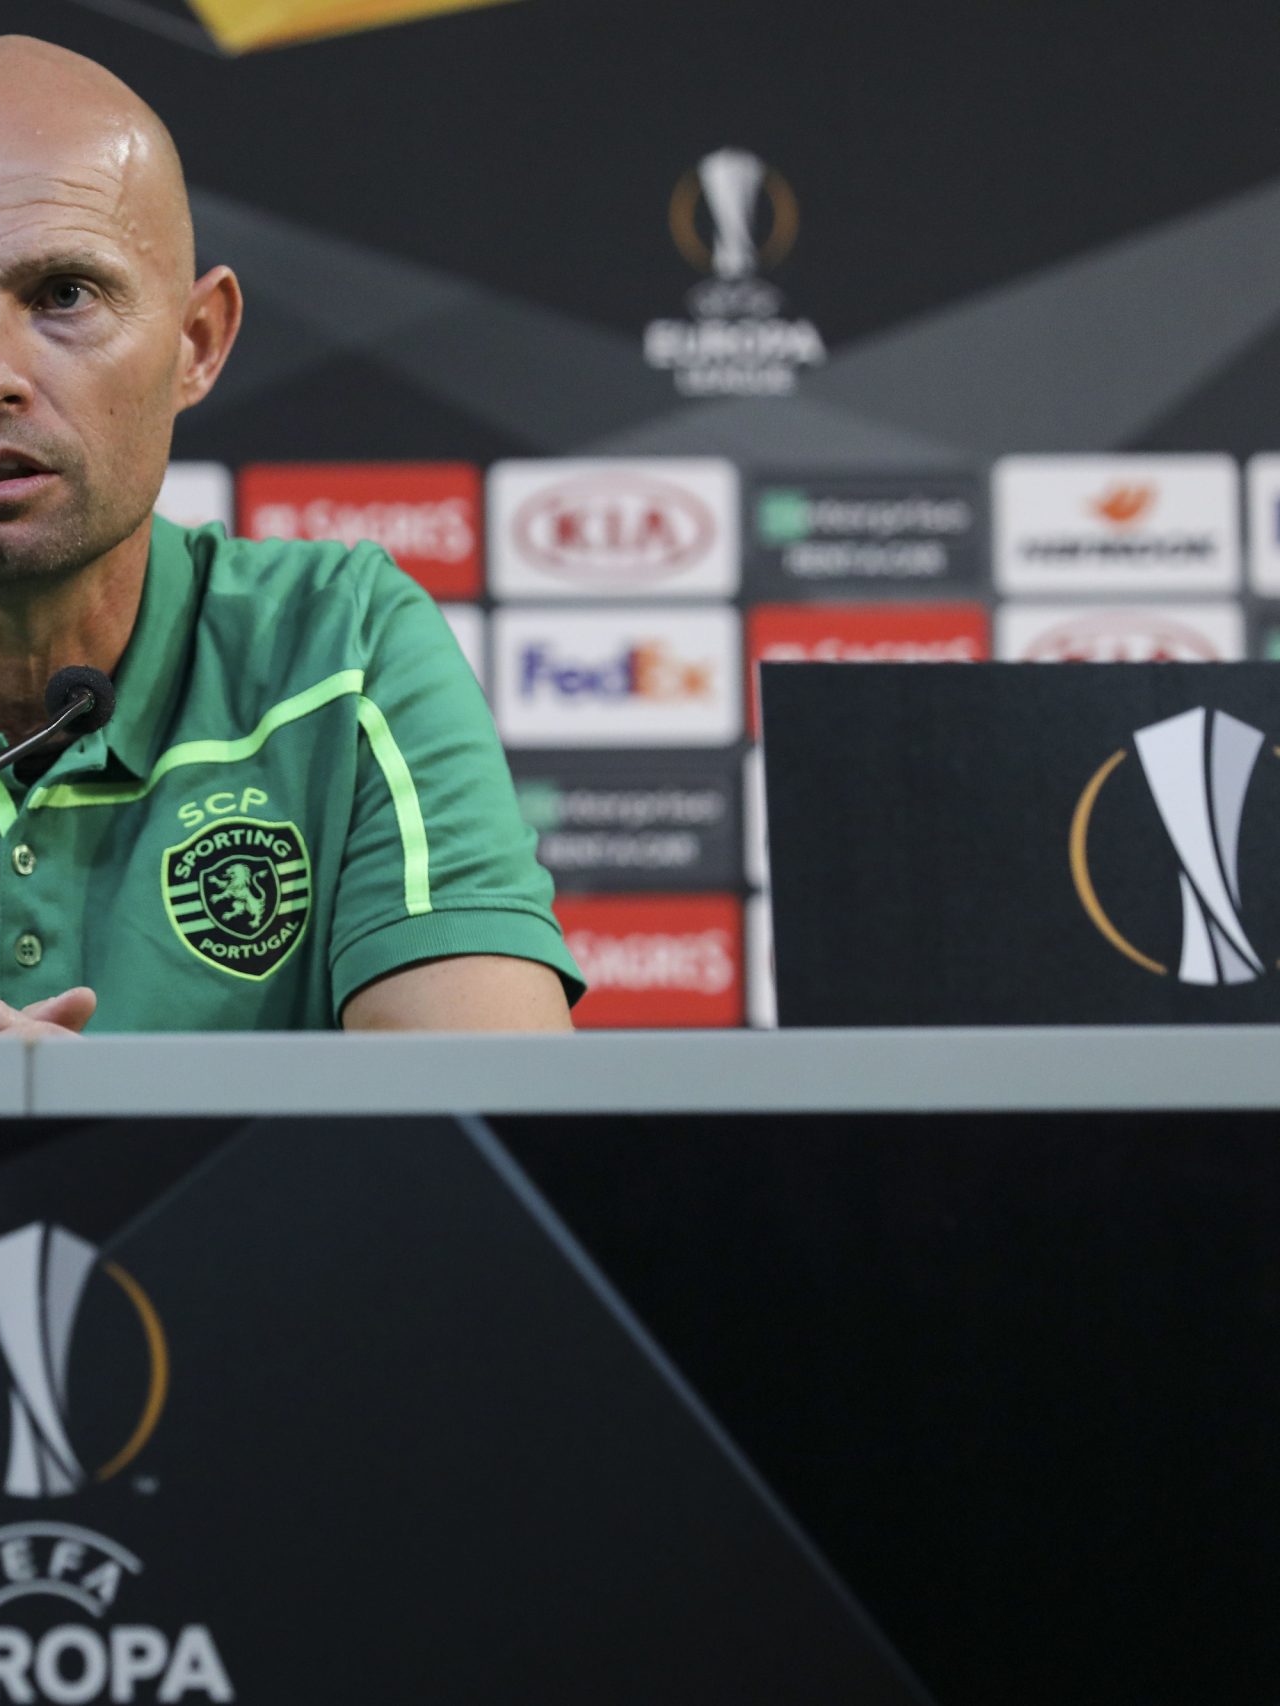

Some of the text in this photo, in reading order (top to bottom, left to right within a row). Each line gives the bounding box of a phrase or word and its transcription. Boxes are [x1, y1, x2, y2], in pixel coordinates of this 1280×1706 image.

[554, 505, 680, 554] KIA
[520, 637, 715, 706] FedEx
[177, 786, 269, 828] SCP
[174, 829, 293, 879] SPORTING
[199, 920, 301, 960] PORTUGAL
